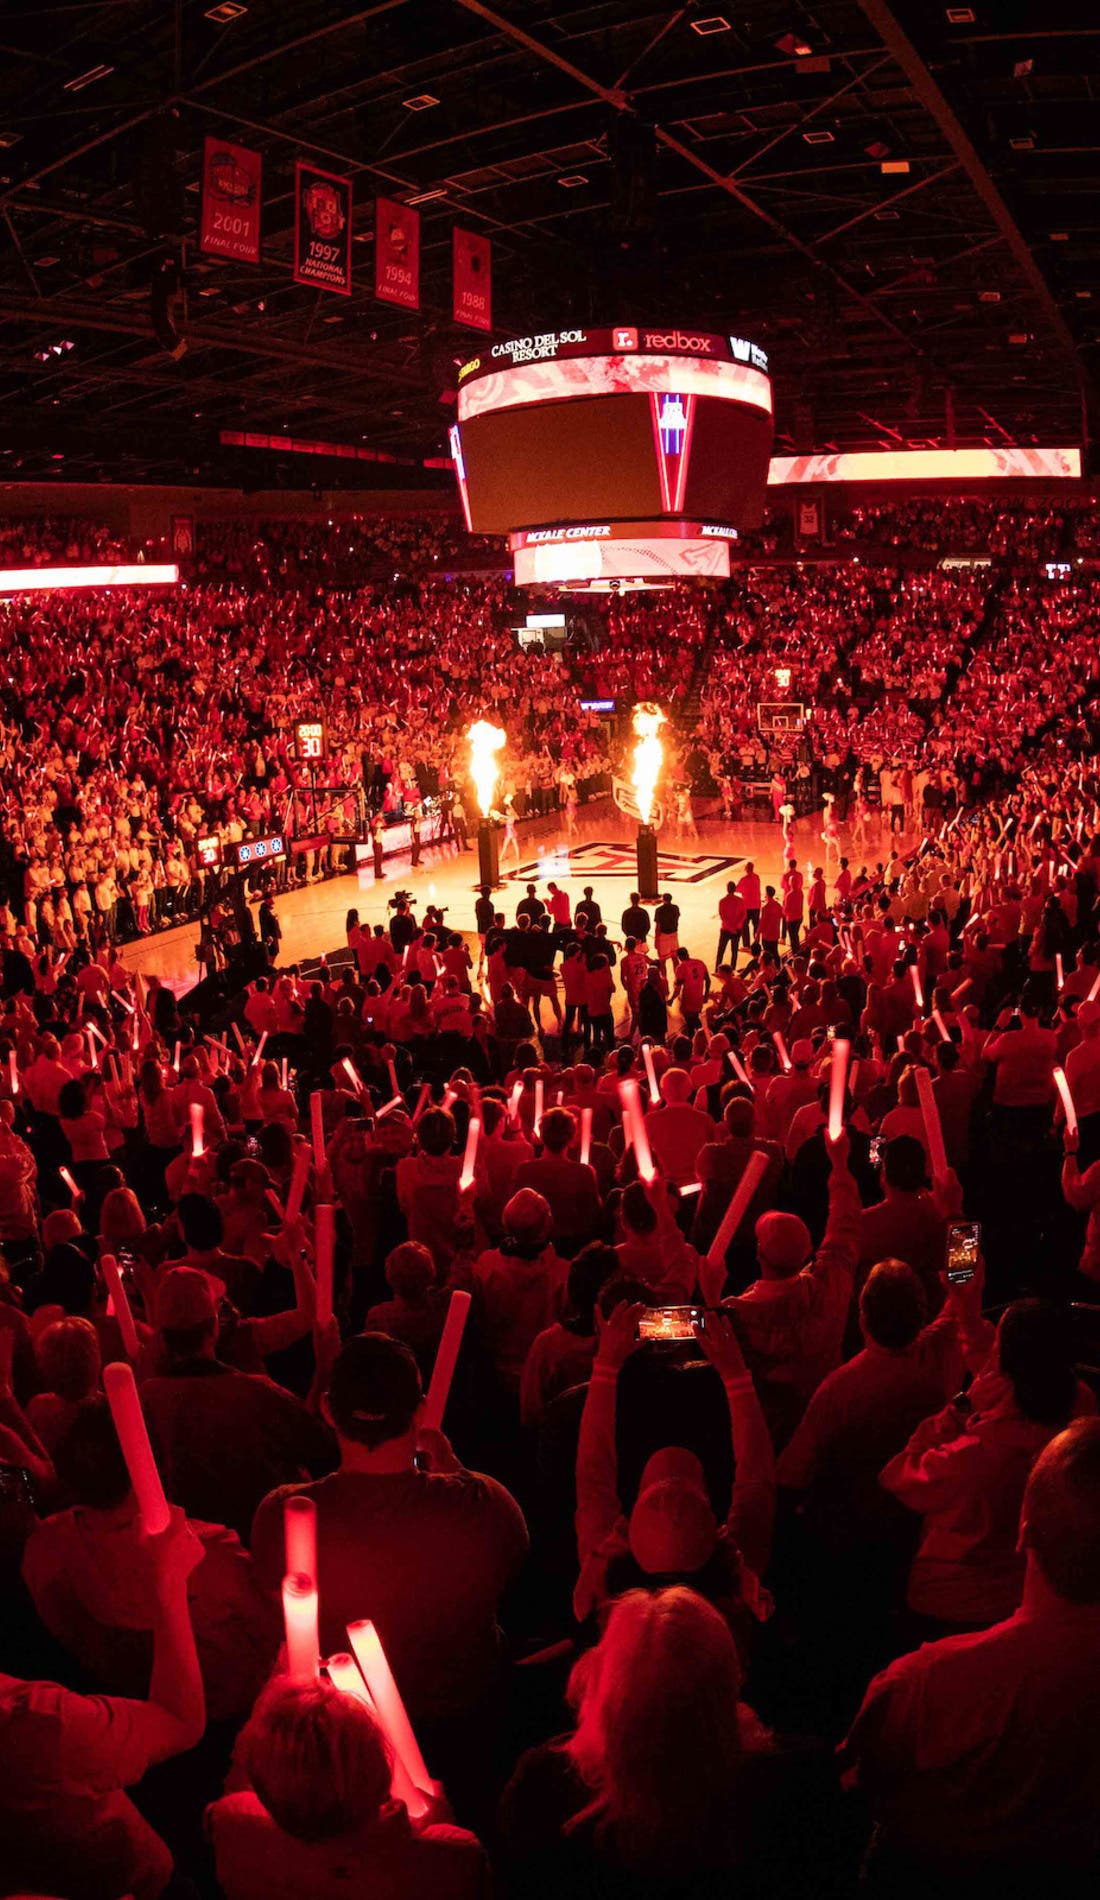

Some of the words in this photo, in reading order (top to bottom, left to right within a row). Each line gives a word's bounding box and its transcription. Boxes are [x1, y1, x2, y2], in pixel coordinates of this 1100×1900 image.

[213, 212, 250, 237] 2001
[204, 234, 231, 249] FINAL
[233, 241, 257, 255] FOUR
[309, 240, 340, 262] 1997
[299, 265, 346, 285] CHAMPIONS
[305, 258, 344, 275] NATIONAL
[385, 265, 412, 285] 1994
[462, 291, 486, 310] 1988
[491, 337, 533, 358] CASINO
[534, 333, 560, 349] DEL
[560, 330, 587, 344] SOL
[645, 330, 712, 352] redbox
[512, 344, 559, 363] RESORT
[565, 525, 611, 539] CENTER
[302, 737, 321, 758] 30
